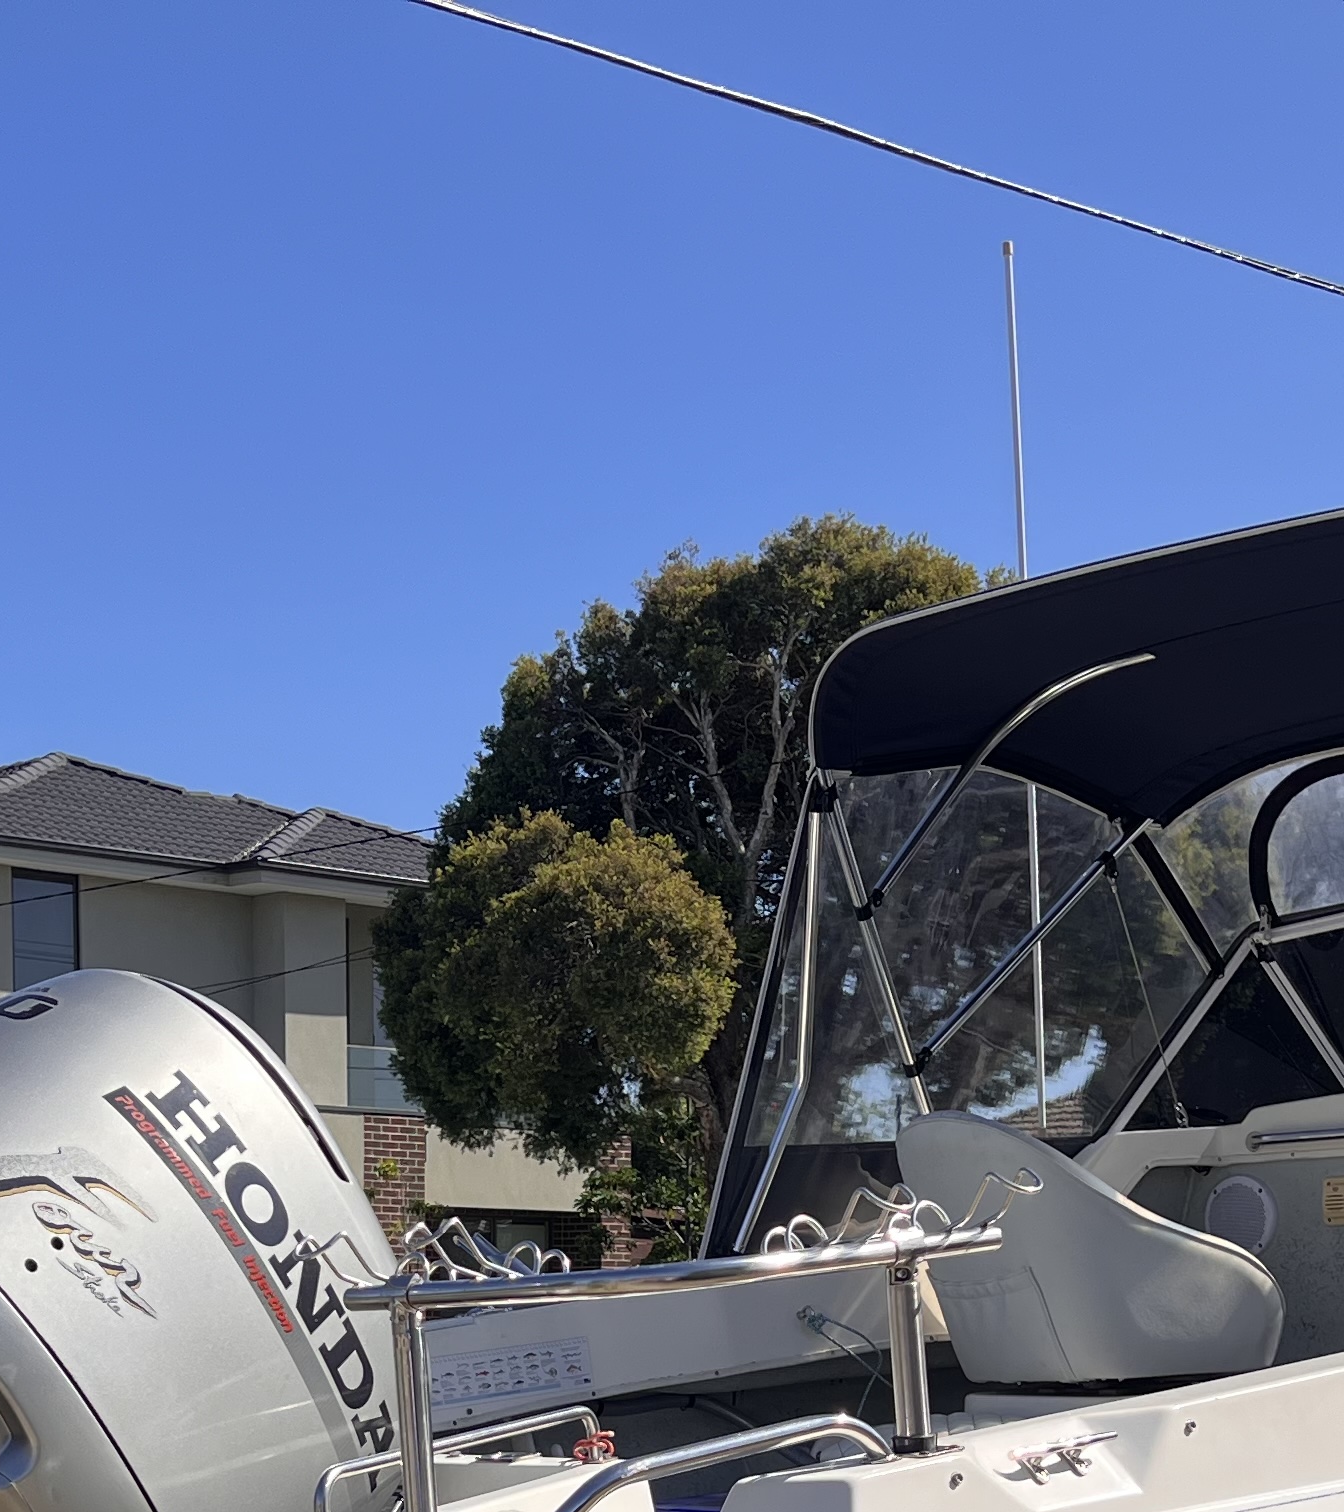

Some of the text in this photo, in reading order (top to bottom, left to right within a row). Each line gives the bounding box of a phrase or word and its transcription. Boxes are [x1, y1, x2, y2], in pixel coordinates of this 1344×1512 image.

[114, 1094, 294, 1335] Programmed Fuel Injection
[145, 1070, 396, 1492] HONDA
